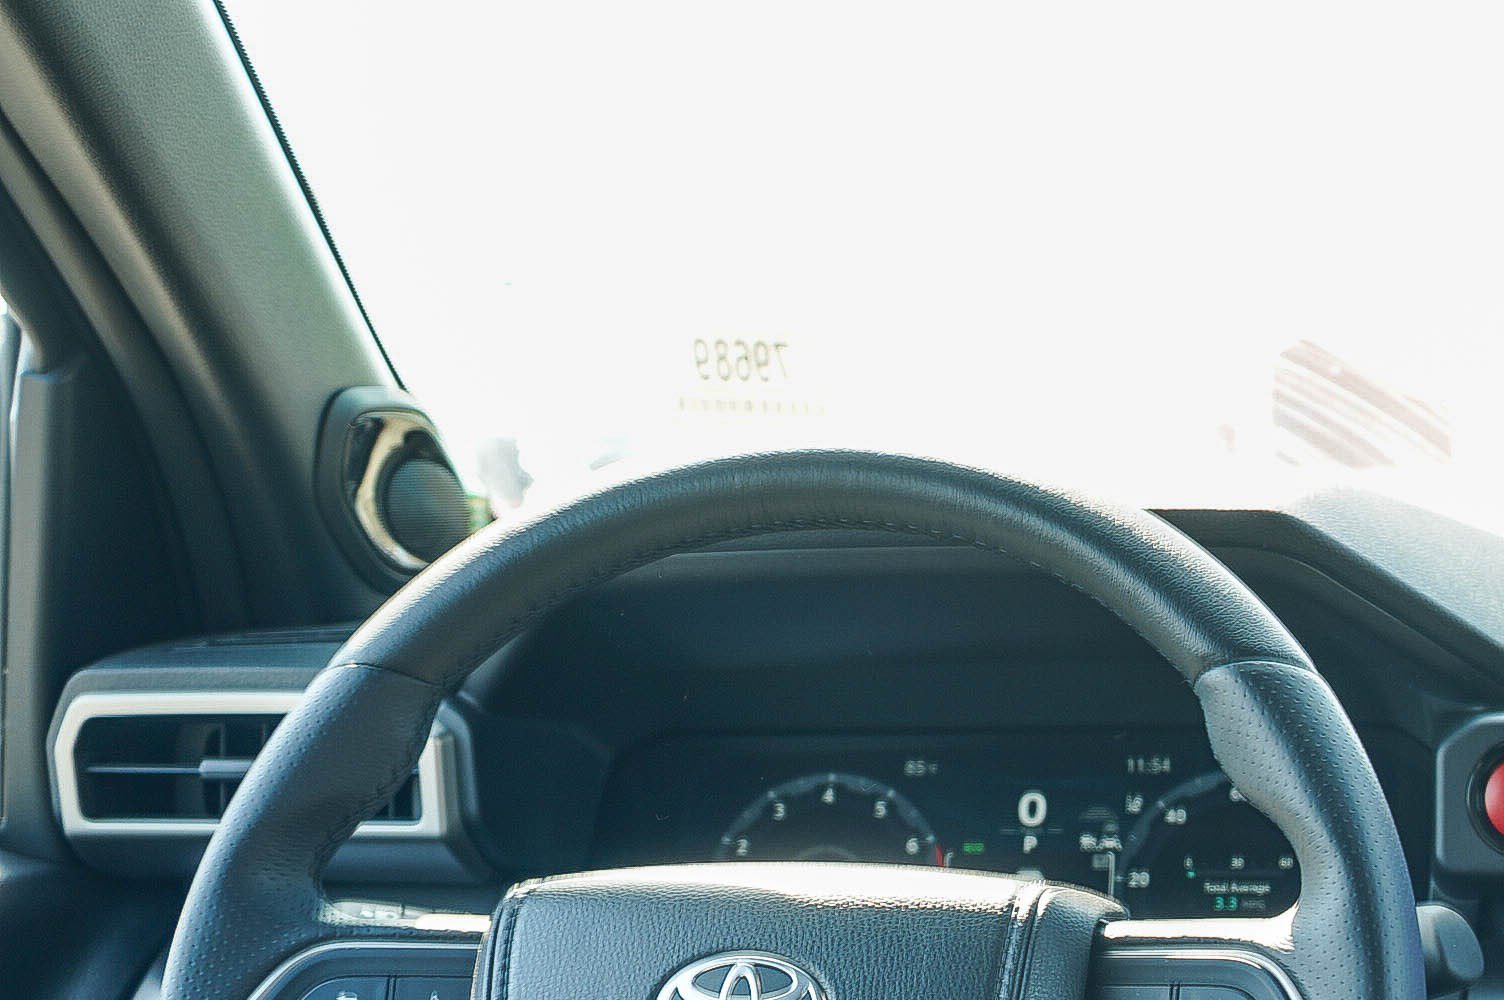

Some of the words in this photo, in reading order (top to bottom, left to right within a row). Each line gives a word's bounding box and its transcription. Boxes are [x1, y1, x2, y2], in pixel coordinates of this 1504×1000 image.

[822, 786, 834, 804] 4
[773, 802, 785, 820] 3
[873, 800, 887, 819] 5
[1017, 791, 1047, 828] 0
[736, 836, 749, 857] 2
[907, 837, 920, 856] 6
[1127, 870, 1150, 889] 20
[1214, 896, 1239, 911] 3.3
